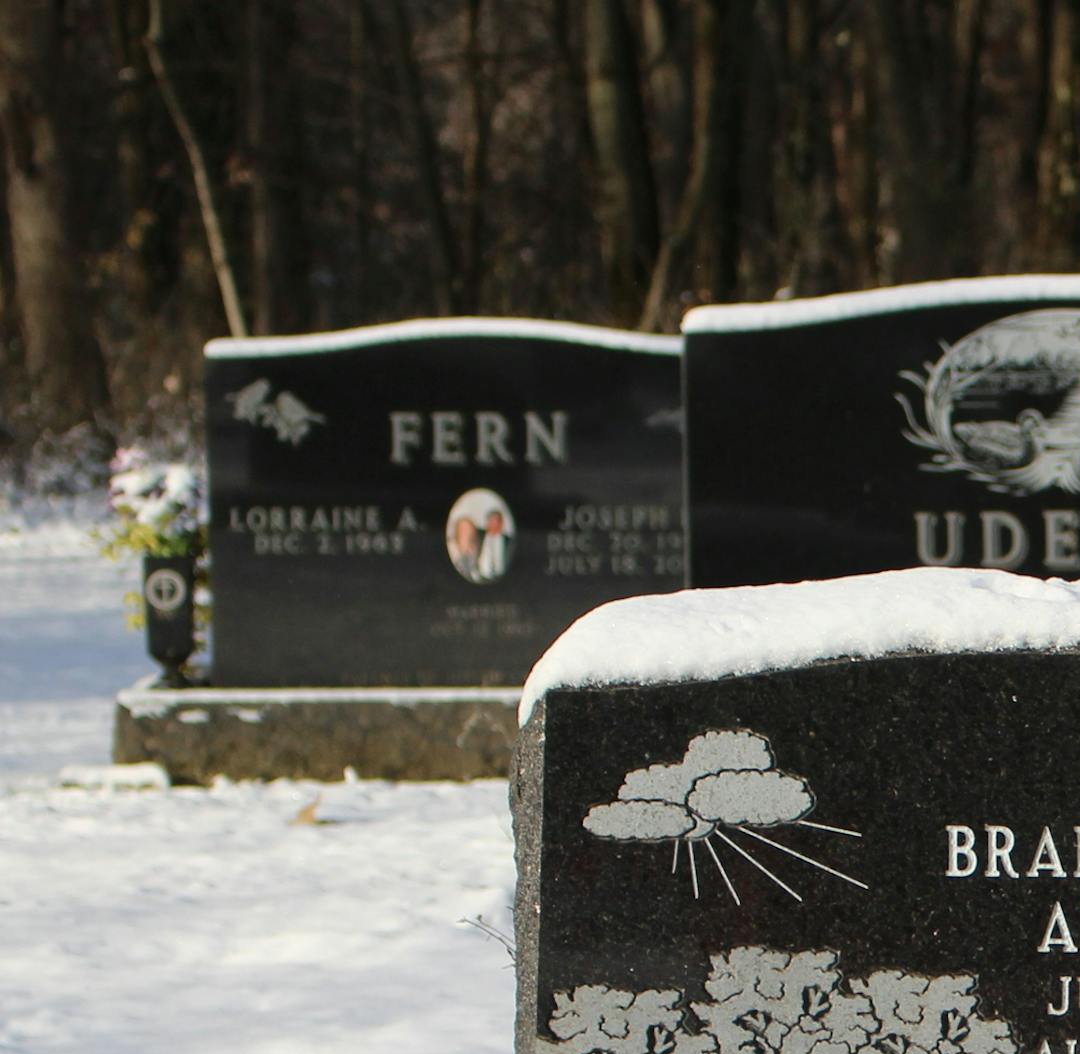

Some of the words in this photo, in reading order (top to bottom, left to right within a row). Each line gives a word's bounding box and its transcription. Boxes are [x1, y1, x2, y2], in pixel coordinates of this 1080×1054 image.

[389, 410, 569, 465] FERN
[229, 506, 382, 533] LORRAINE
[398, 506, 429, 532] A.
[558, 505, 670, 531] JOSEPH
[544, 553, 602, 576] JULY
